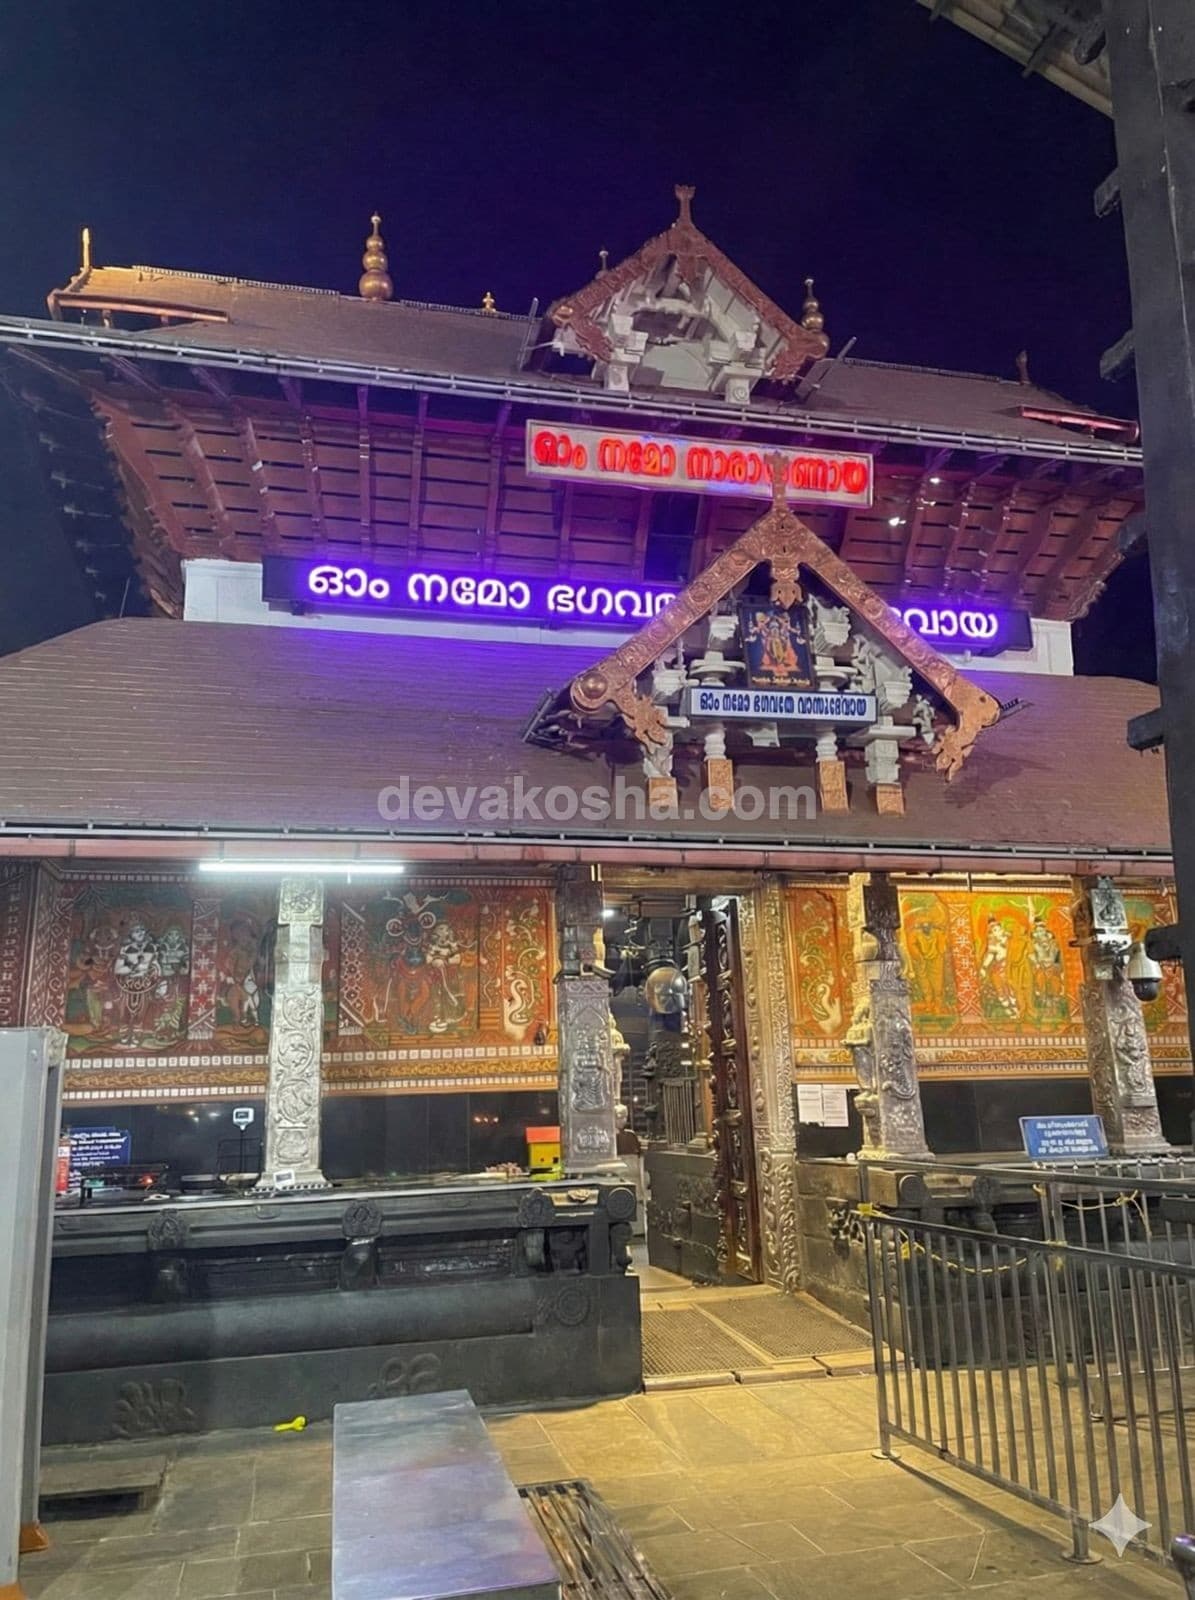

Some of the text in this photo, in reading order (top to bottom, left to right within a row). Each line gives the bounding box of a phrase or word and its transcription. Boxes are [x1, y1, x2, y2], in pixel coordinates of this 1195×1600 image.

[533, 431, 588, 470] ഓം
[597, 438, 677, 477] നമോ
[308, 565, 390, 599] ഓം
[407, 572, 531, 610] നമോ
